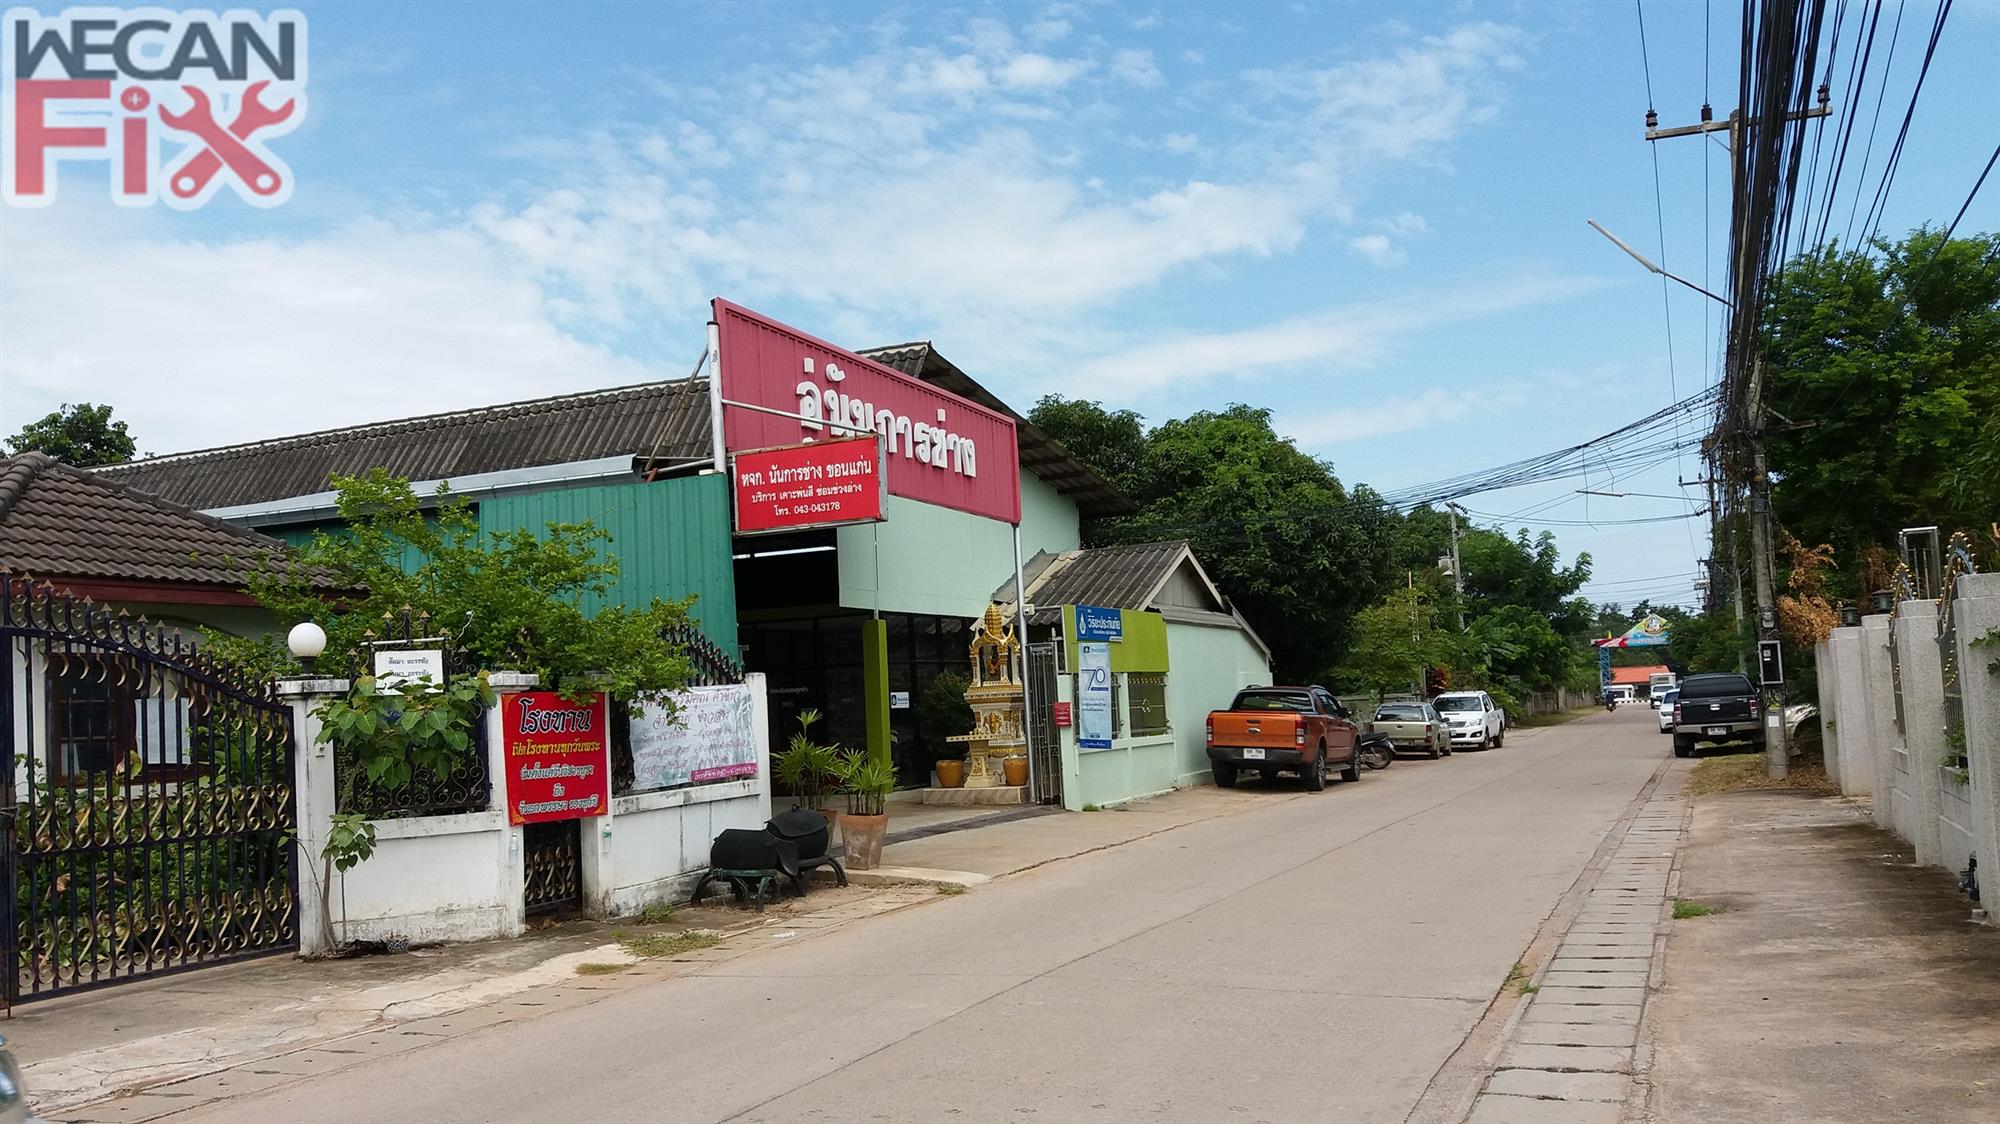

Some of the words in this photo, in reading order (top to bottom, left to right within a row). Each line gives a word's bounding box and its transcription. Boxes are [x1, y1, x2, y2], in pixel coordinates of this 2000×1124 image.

[796, 357, 977, 478] อ่นันการช่าง
[769, 461, 822, 484] นันการช่าง
[826, 455, 872, 478] ขอนแก่น
[751, 491, 777, 503] บริการ
[779, 485, 814, 501] เคาะพ่นสี
[774, 504, 791, 517] โทร.
[793, 501, 841, 515] 043-043178
[1081, 668, 1106, 691] 70
[519, 697, 592, 734] โรงทาน
[512, 738, 600, 758] เปิดโรงทานทุกวันพระ
